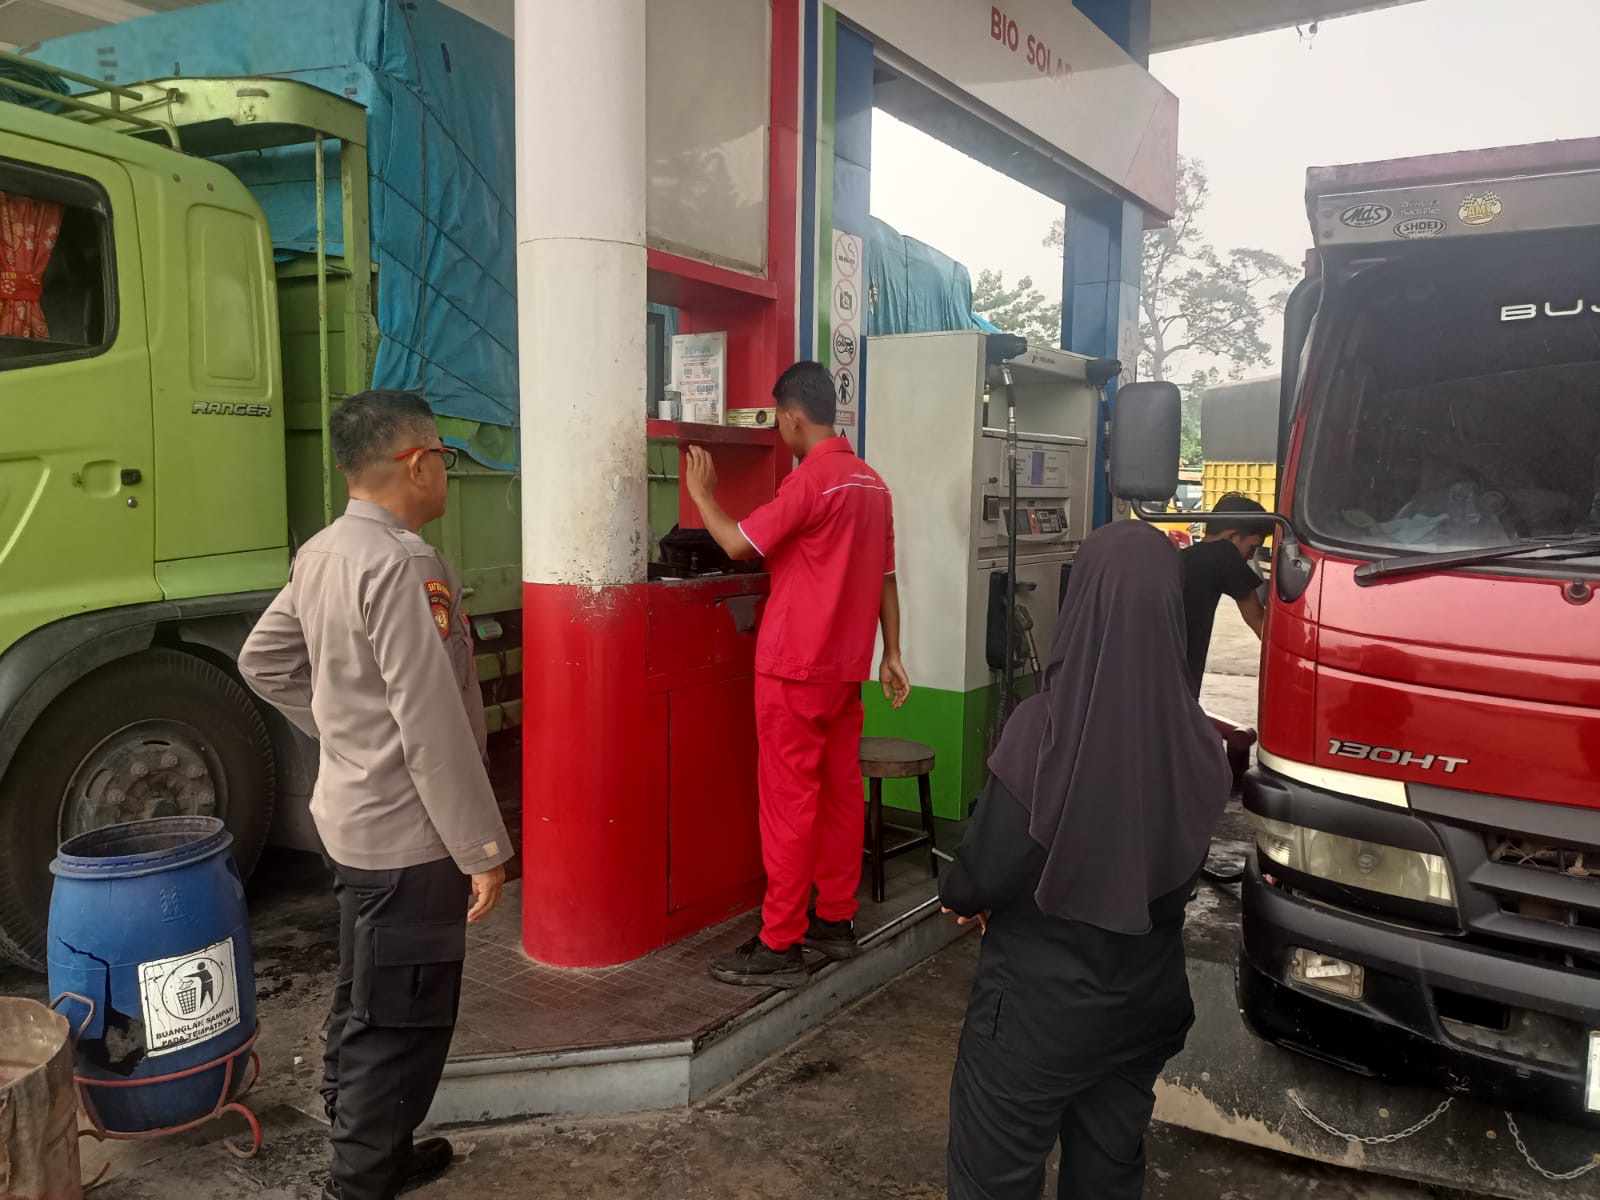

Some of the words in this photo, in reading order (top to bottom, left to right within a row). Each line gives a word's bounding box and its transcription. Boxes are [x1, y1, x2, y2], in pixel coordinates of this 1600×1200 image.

[991, 6, 1018, 52] BIO
[1403, 221, 1438, 231] SHOEI
[1501, 299, 1600, 321] BU
[192, 401, 271, 417] RANGER
[1328, 739, 1469, 773] 130HT
[156, 1021, 203, 1039] BUANGLAH
[206, 1006, 234, 1023] SAMPAH
[162, 1035, 185, 1047] PADA
[187, 1016, 232, 1039] TEMPATNYA
